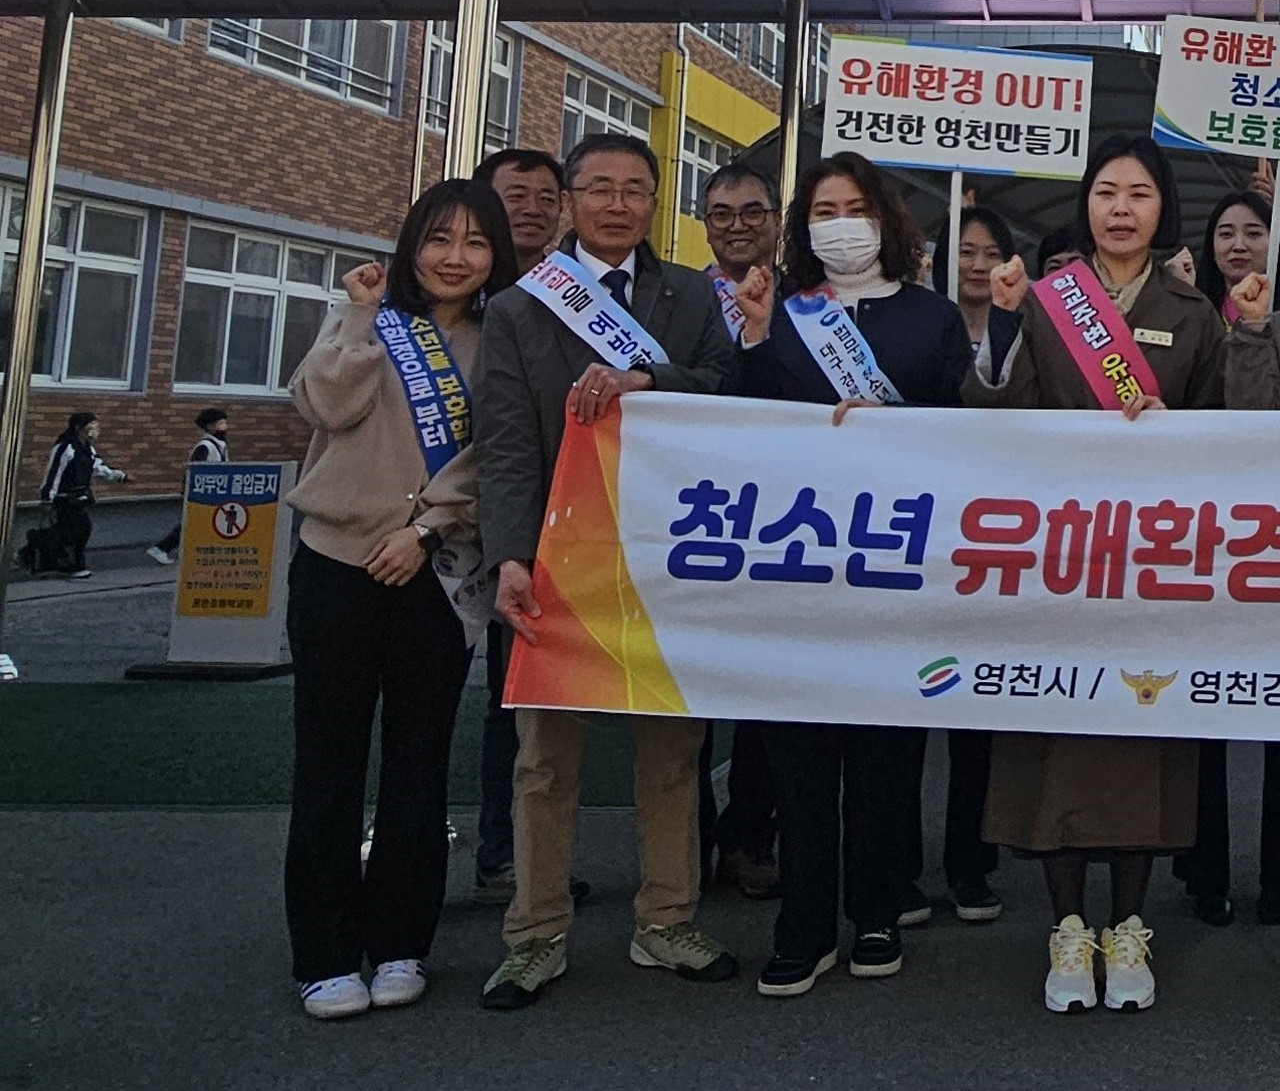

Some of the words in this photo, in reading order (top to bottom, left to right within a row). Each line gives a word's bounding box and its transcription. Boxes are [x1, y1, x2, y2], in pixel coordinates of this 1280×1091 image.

[838, 57, 985, 107] 유해환경
[995, 73, 1084, 114] OUT!
[835, 108, 927, 147] 건전한
[934, 114, 1081, 158] 영천만들기
[375, 308, 436, 401] 해환경으로
[408, 315, 452, 372] 소년을
[192, 473, 229, 495] 외부인
[231, 473, 278, 495] 출입금지
[666, 479, 935, 592] 청소년
[973, 663, 1080, 701] 영천시
